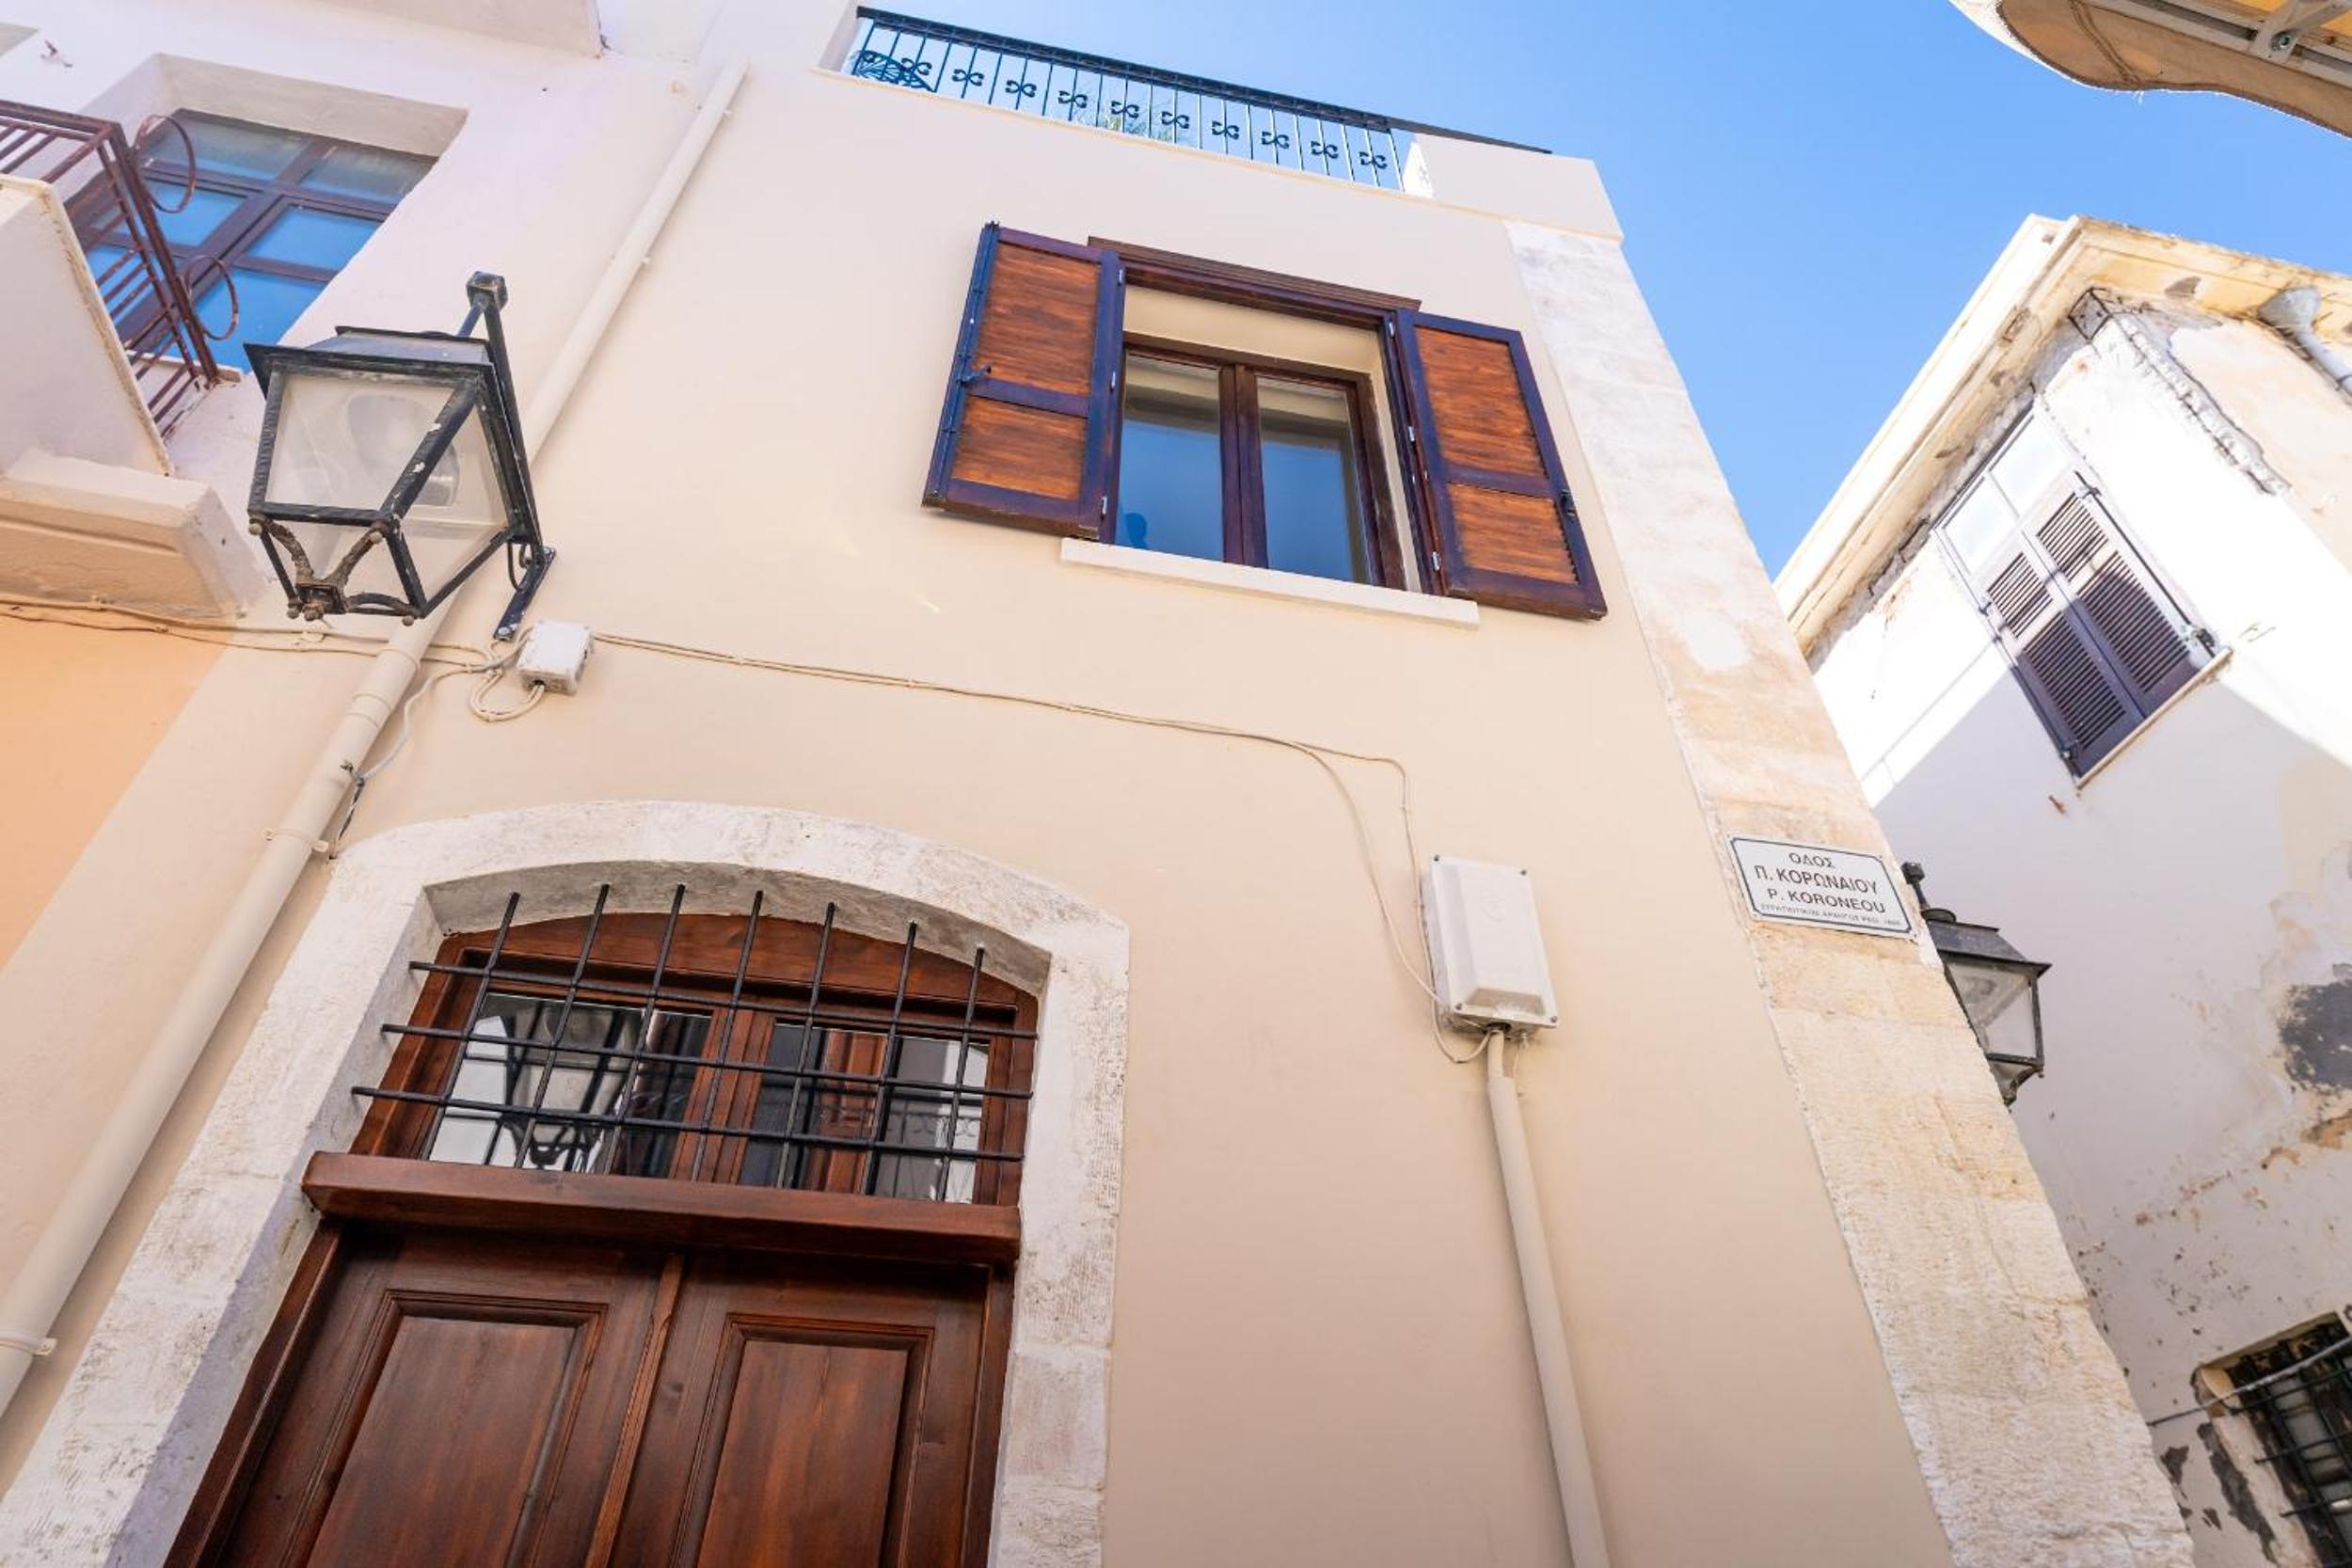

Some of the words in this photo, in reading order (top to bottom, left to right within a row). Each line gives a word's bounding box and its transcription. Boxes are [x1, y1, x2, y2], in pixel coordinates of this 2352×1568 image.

[1788, 852, 1836, 868] ΟΔΟΣ
[1754, 864, 1774, 880] Π.
[1775, 867, 1878, 895] ΚΟΡΩΝΑΙΟΥ
[1788, 890, 1885, 913] KORONEOU
